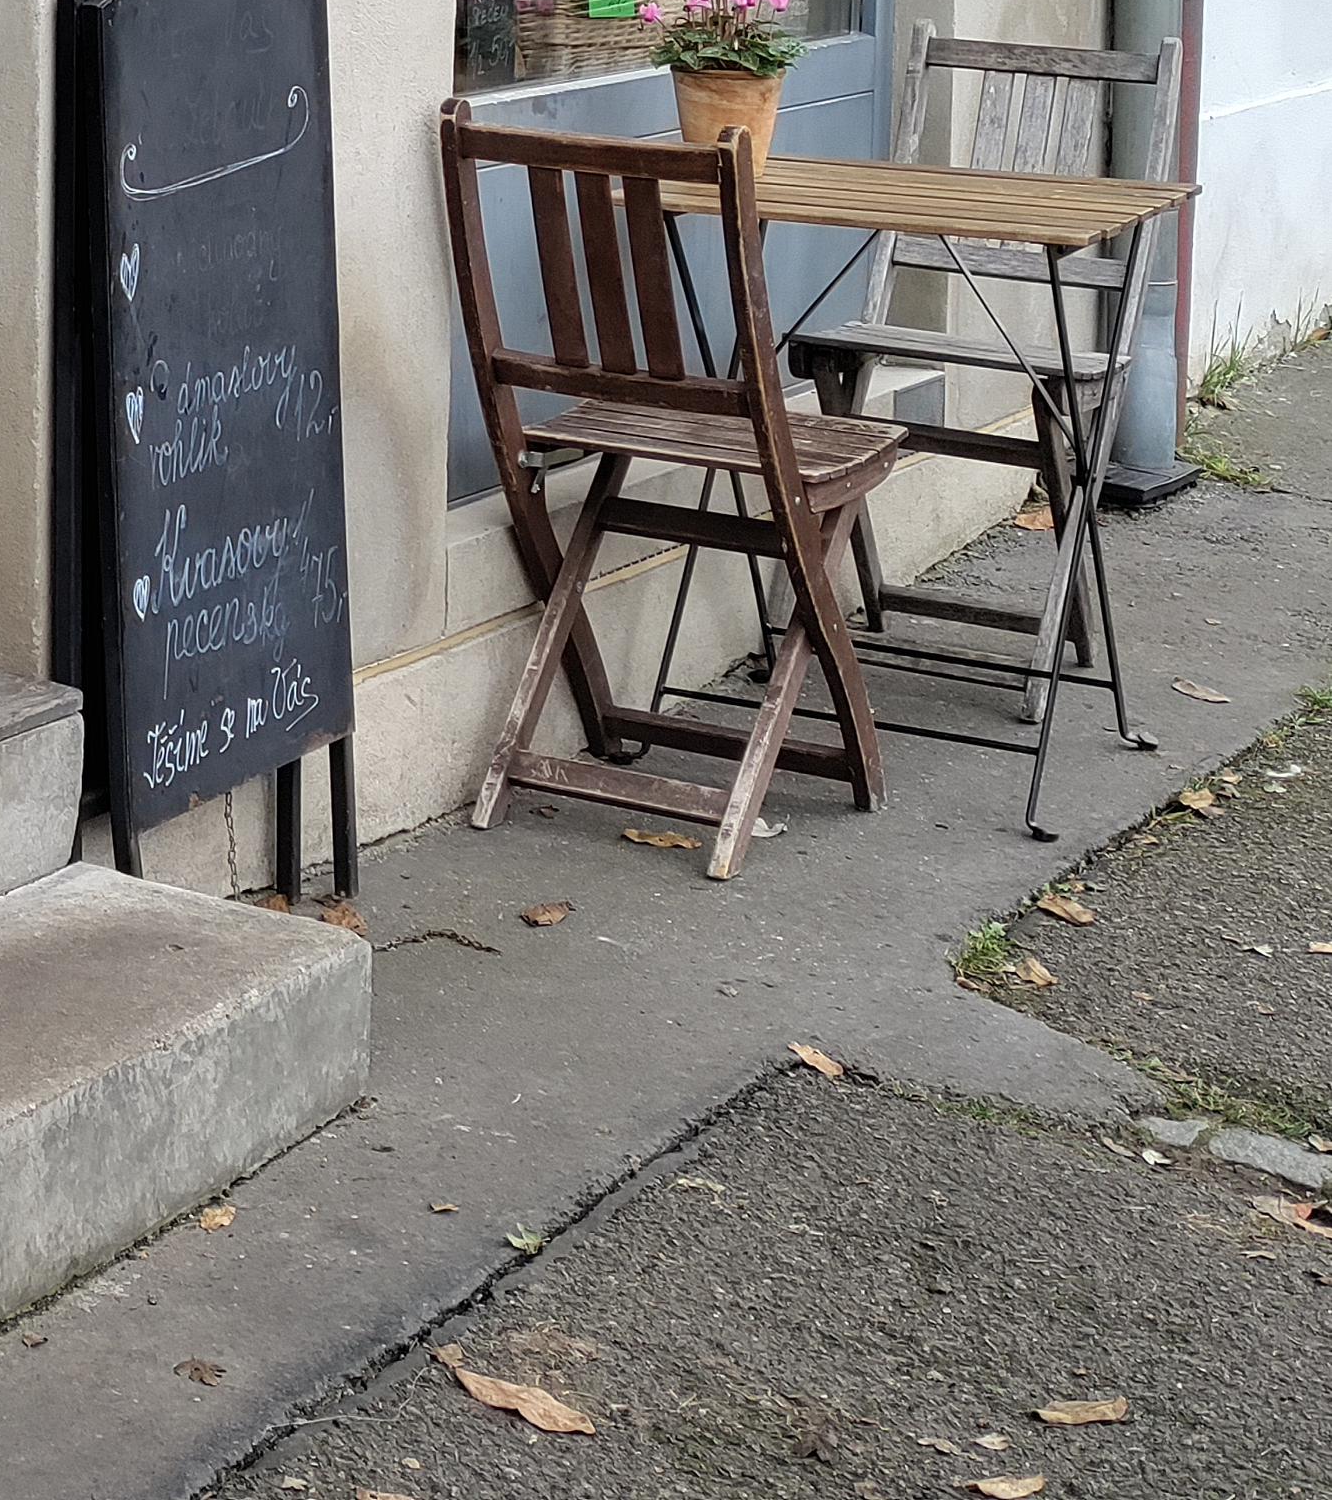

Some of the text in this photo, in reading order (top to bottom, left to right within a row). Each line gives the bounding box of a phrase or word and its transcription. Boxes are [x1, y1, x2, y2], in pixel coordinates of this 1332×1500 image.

[143, 658, 319, 789] Těšíme se na Vás
